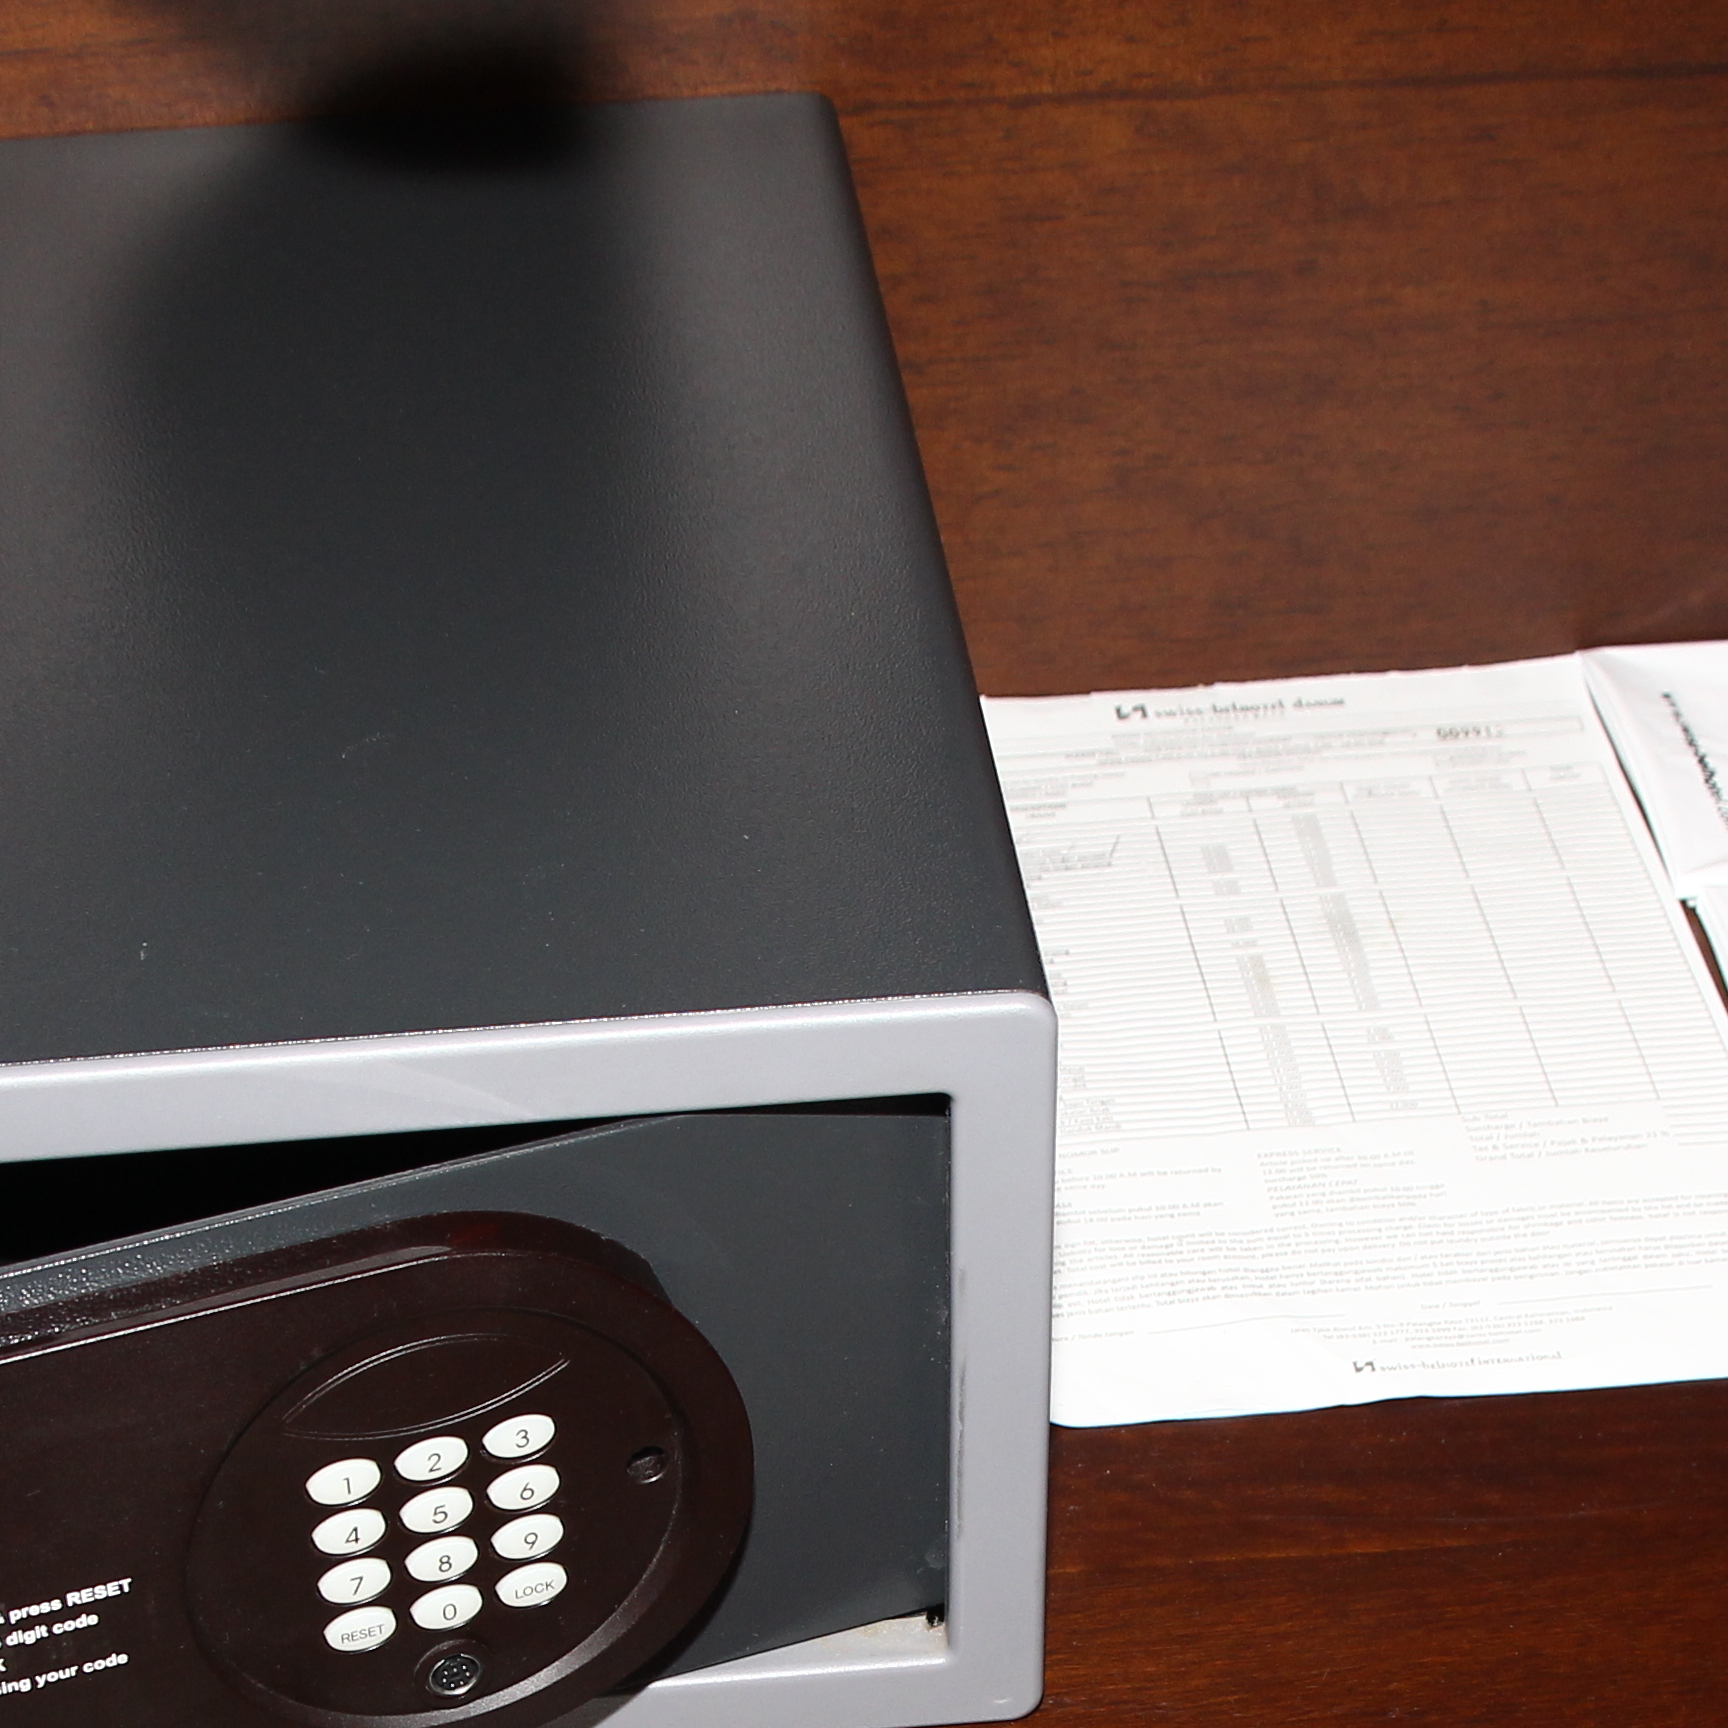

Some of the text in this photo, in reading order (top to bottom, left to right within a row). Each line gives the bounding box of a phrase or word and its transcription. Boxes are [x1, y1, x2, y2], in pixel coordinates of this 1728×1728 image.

[515, 1428, 531, 1448] 3
[427, 1452, 443, 1473] 2
[342, 1476, 352, 1496] 1
[520, 1481, 536, 1501] 6
[431, 1504, 449, 1524] 5
[344, 1526, 361, 1545] 4
[523, 1531, 539, 1551] 9
[437, 1554, 453, 1573] 8
[349, 1576, 364, 1596] 7
[514, 1579, 556, 1600] LOCK
[8, 1598, 63, 1625] press
[65, 1577, 132, 1607] RESET
[442, 1603, 457, 1621] 0
[5, 1624, 49, 1647] digit
[51, 1613, 99, 1635] code
[340, 1623, 385, 1645] RESET
[34, 1665, 79, 1689] your
[82, 1652, 129, 1673] code
